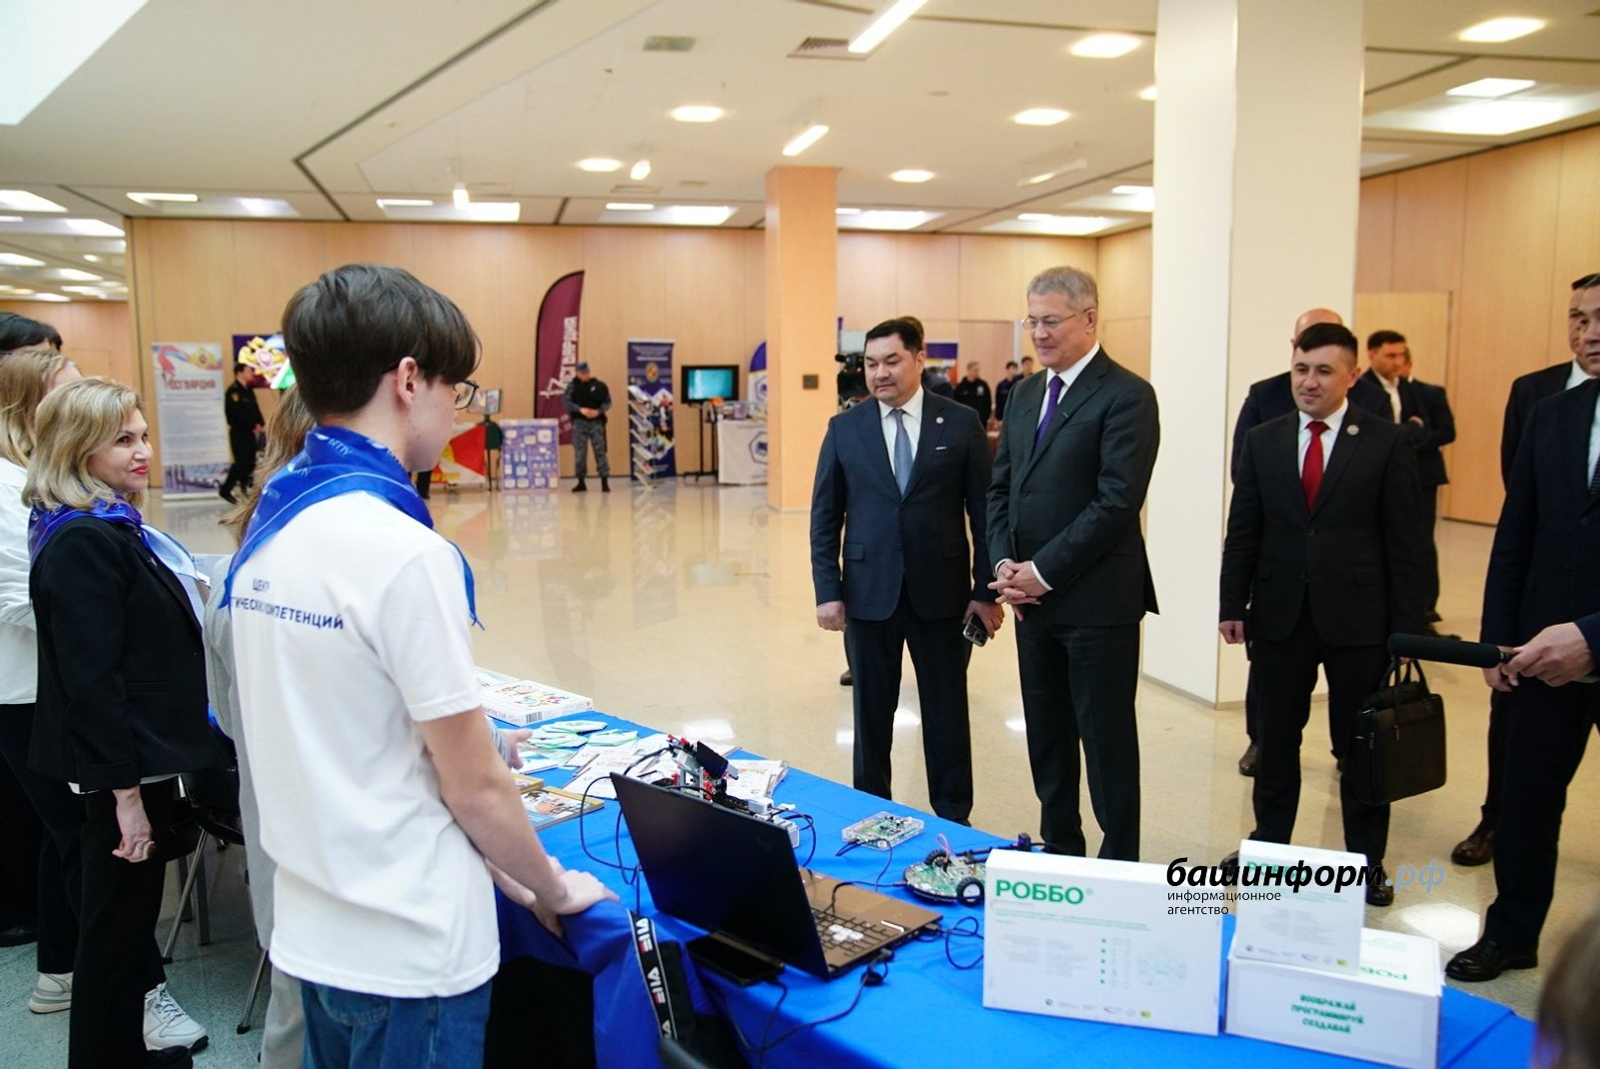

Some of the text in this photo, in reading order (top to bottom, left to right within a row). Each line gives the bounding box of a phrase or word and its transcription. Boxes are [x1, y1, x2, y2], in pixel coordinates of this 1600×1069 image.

[995, 879, 1084, 904] РОББО
[636, 918, 653, 953] FILA
[647, 966, 666, 1004] FILA
